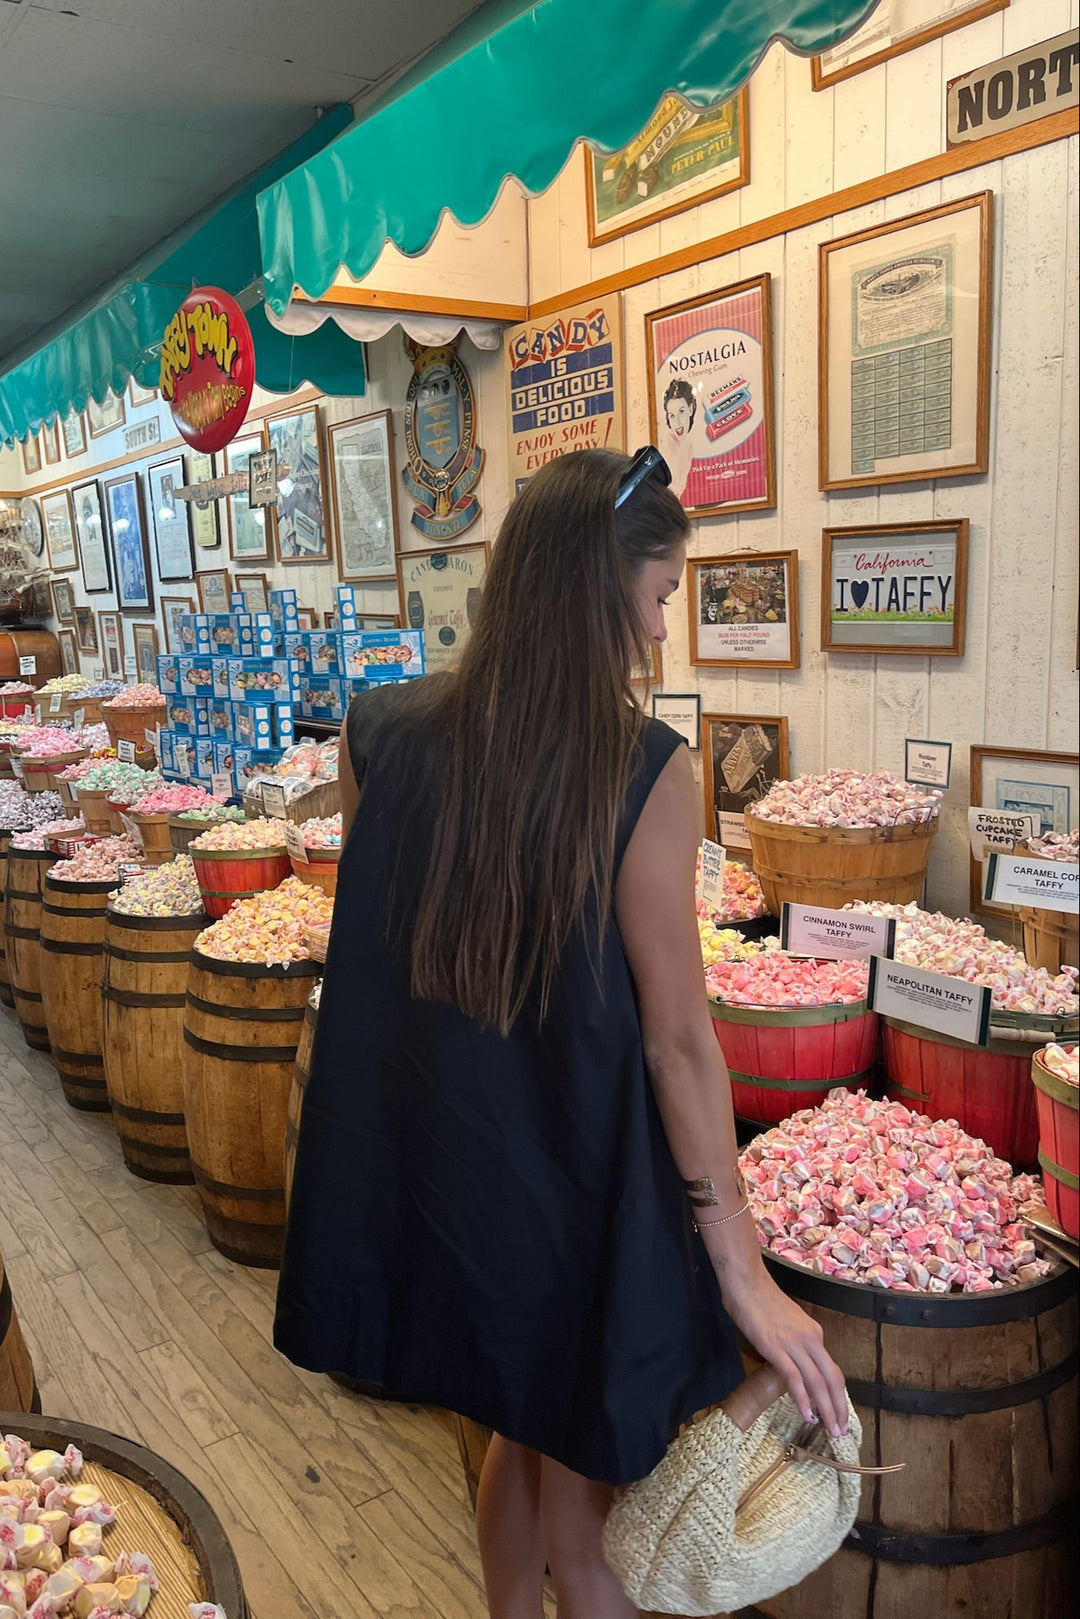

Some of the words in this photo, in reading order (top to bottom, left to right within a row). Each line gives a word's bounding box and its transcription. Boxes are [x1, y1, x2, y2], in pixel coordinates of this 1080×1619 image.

[671, 150, 704, 174] PETER
[707, 136, 733, 156] PAUL
[515, 313, 606, 359] CANDY
[551, 357, 567, 378] IS
[669, 340, 746, 374] NOSTALGIA
[516, 371, 609, 410] DELICIOUS
[710, 377, 742, 398] BEEMANS
[536, 399, 586, 427] FOOD
[516, 432, 555, 456] ENJOY
[561, 419, 598, 443] SOME
[855, 552, 934, 575] California
[836, 578, 849, 612] I
[871, 575, 952, 612] TAFFY
[975, 824, 1023, 837] CUPCAKE
[977, 813, 1025, 828] FROSTED
[1013, 866, 1059, 879] CARAMEL
[1034, 878, 1064, 890] TAFFY
[802, 915, 848, 930] CINNAMON
[849, 922, 876, 934] SWIRL
[826, 928, 852, 939] TAFFY
[887, 974, 942, 996] NEAPOLITAN
[944, 990, 973, 1006] TAFFY
